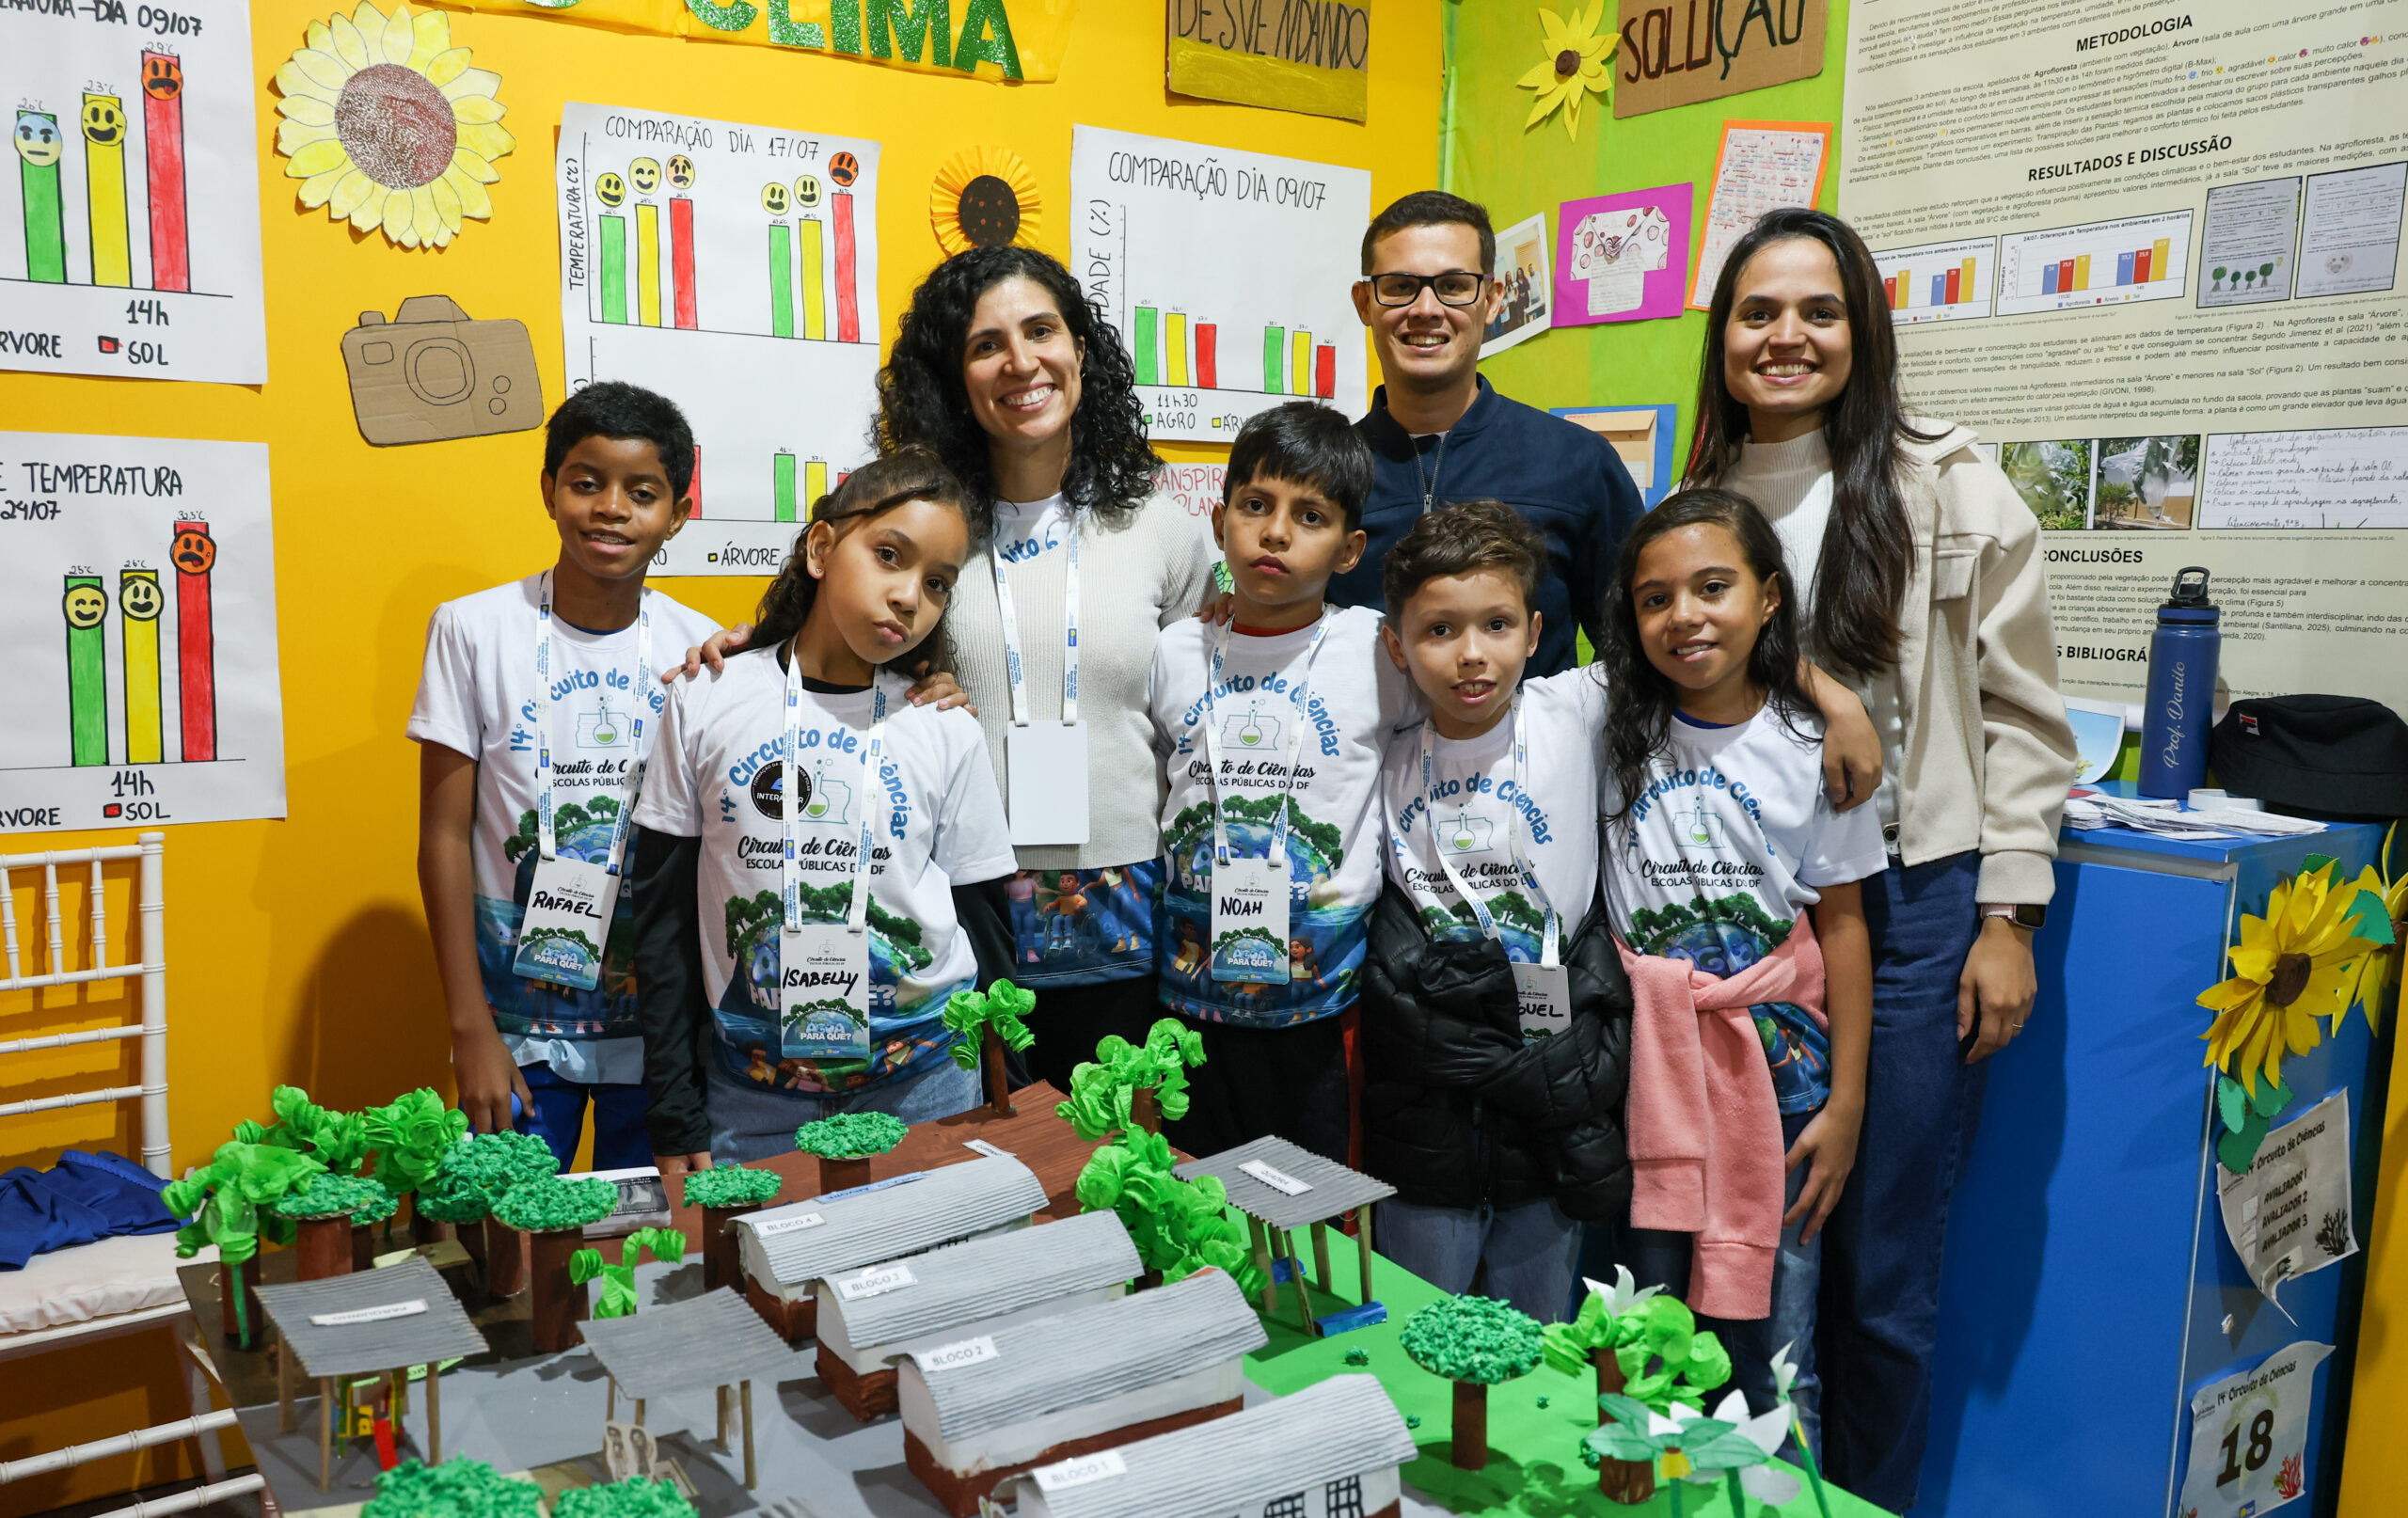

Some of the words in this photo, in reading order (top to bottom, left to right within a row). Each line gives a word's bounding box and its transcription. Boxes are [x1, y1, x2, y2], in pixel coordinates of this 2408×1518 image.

[137, 6, 202, 37] 09/07
[2173, 38, 2199, 48] Árvore
[2319, 7, 2347, 19] grande
[2076, 14, 2194, 52] METODOLOGIA
[2227, 58, 2266, 72] agradável
[2337, 40, 2358, 50] calor
[2034, 63, 2078, 77] Agrofloresta
[2307, 77, 2365, 92] transparentes
[2368, 70, 2398, 83] galhos
[605, 115, 713, 150] COMPARAÇÃO
[768, 137, 819, 161] 17/07
[2027, 153, 2123, 182] RESULTADOS
[2127, 151, 2135, 166] E
[2140, 134, 2232, 164] DISCUSSÃO
[1108, 151, 1228, 200] COMPARAÇÃO
[1276, 178, 1326, 210] 09/07
[566, 186, 585, 292] TEMPERATURA
[126, 299, 169, 326] 14h
[2334, 336, 2380, 346] capacidade
[128, 340, 168, 365] SOL
[1158, 393, 1198, 408] 11h30
[2266, 391, 2302, 400] provando
[2332, 387, 2362, 396] plantas
[2282, 402, 2308, 411] grande
[2385, 397, 2407, 406] água
[1157, 412, 1196, 430] AGRO
[1223, 413, 1245, 432] ÁRV
[22, 462, 182, 498] TEMPERATURA
[1151, 466, 1228, 492] RANSPIR
[0, 500, 61, 520] 24/07
[721, 541, 780, 566] ÁRVORE
[2210, 577, 2250, 585] percepção
[2273, 577, 2312, 586] agradável
[2230, 610, 2264, 619] profunda
[2306, 624, 2332, 633] 2025),
[2335, 625, 2383, 634] culminando
[2067, 646, 2147, 662] BIBLIOGRÁ
[521, 669, 599, 722] Ccuito
[605, 667, 630, 691] de
[2166, 661, 2186, 721] Danilo
[1261, 671, 1288, 694] de
[1289, 686, 1340, 757] Cências
[2163, 723, 2186, 768] Prof.
[534, 759, 594, 779] rcuito
[596, 759, 617, 774] de
[1237, 760, 1255, 775] de
[1257, 761, 1317, 779] Ciênias
[1699, 765, 1726, 790] de
[111, 771, 154, 797] 14h
[553, 778, 592, 787] SCOLAS
[593, 775, 626, 787] PÚBLIC
[729, 728, 820, 787] Circuto
[827, 727, 858, 753] de
[860, 749, 912, 841] Cências
[1231, 776, 1275, 788] PÚBLICAS
[1296, 780, 1310, 790] DF
[1465, 771, 1493, 794] de
[126, 803, 170, 821] SOL
[737, 835, 784, 859] Circui
[801, 836, 822, 855] de
[746, 859, 784, 870] ESCOLA
[799, 859, 847, 873] ÚBLICAS
[1404, 867, 1450, 884] Circui
[1460, 862, 1478, 879] de
[1693, 859, 1708, 874] de
[1413, 882, 1454, 894] ESCOLAS
[1468, 878, 1502, 891] BLICAS
[1696, 876, 1733, 887] ÚBLICAS
[1749, 878, 1762, 888] DF
[532, 890, 603, 919] RAFAEL
[1220, 895, 1262, 916] NOAH
[534, 955, 558, 966] PARA
[1228, 957, 1250, 966] PARA
[783, 966, 859, 997] ISABELLY
[800, 1032, 825, 1040] PARA
[2263, 1170, 2304, 1205] AVALIADOR
[2262, 1194, 2303, 1229] AVALIADOR
[767, 1219, 801, 1232] BLOCO
[2261, 1218, 2303, 1253] AVALIADOR
[851, 1275, 888, 1291] BLOCO
[932, 1349, 974, 1366] BLOCO
[2216, 1409, 2274, 1488] 18
[1051, 1465, 1098, 1485] BLOCO
